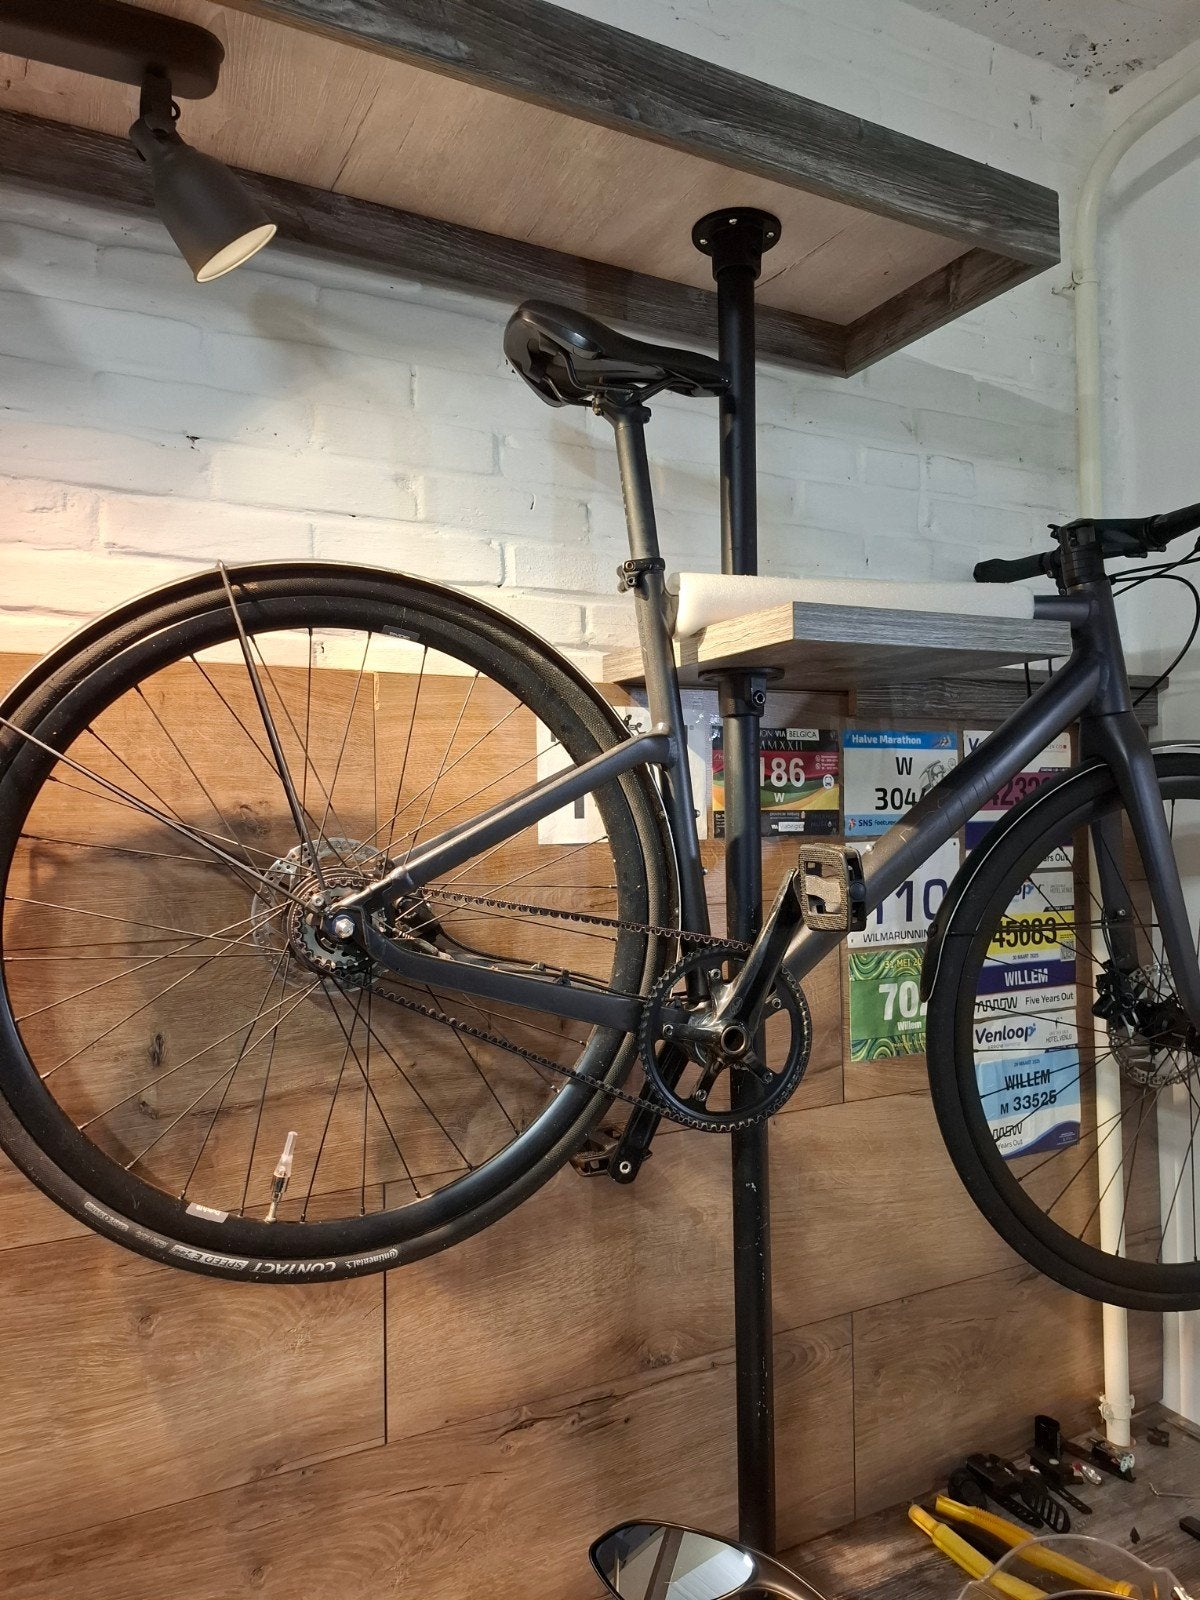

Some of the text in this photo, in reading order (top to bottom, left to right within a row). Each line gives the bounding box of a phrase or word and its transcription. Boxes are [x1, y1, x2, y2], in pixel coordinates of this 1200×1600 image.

[788, 730, 817, 739] BELGICA
[852, 733, 922, 745] Halve Marathon
[895, 756, 913, 776] W
[774, 792, 785, 803] W
[858, 819, 873, 827] SNS
[897, 958, 911, 967] MEI
[913, 957, 924, 966] 20
[1004, 968, 1048, 987] WILLEM
[1026, 996, 1040, 1006] Five
[1041, 994, 1061, 1003] Years
[1061, 991, 1074, 1001] Out
[897, 1020, 922, 1031] Willem
[975, 1023, 1037, 1045] Venloop
[1004, 1069, 1051, 1091] WILLEM
[1000, 1103, 1009, 1115] M
[204, 1254, 243, 1269] SPEED
[250, 1261, 336, 1275] CONTACT
